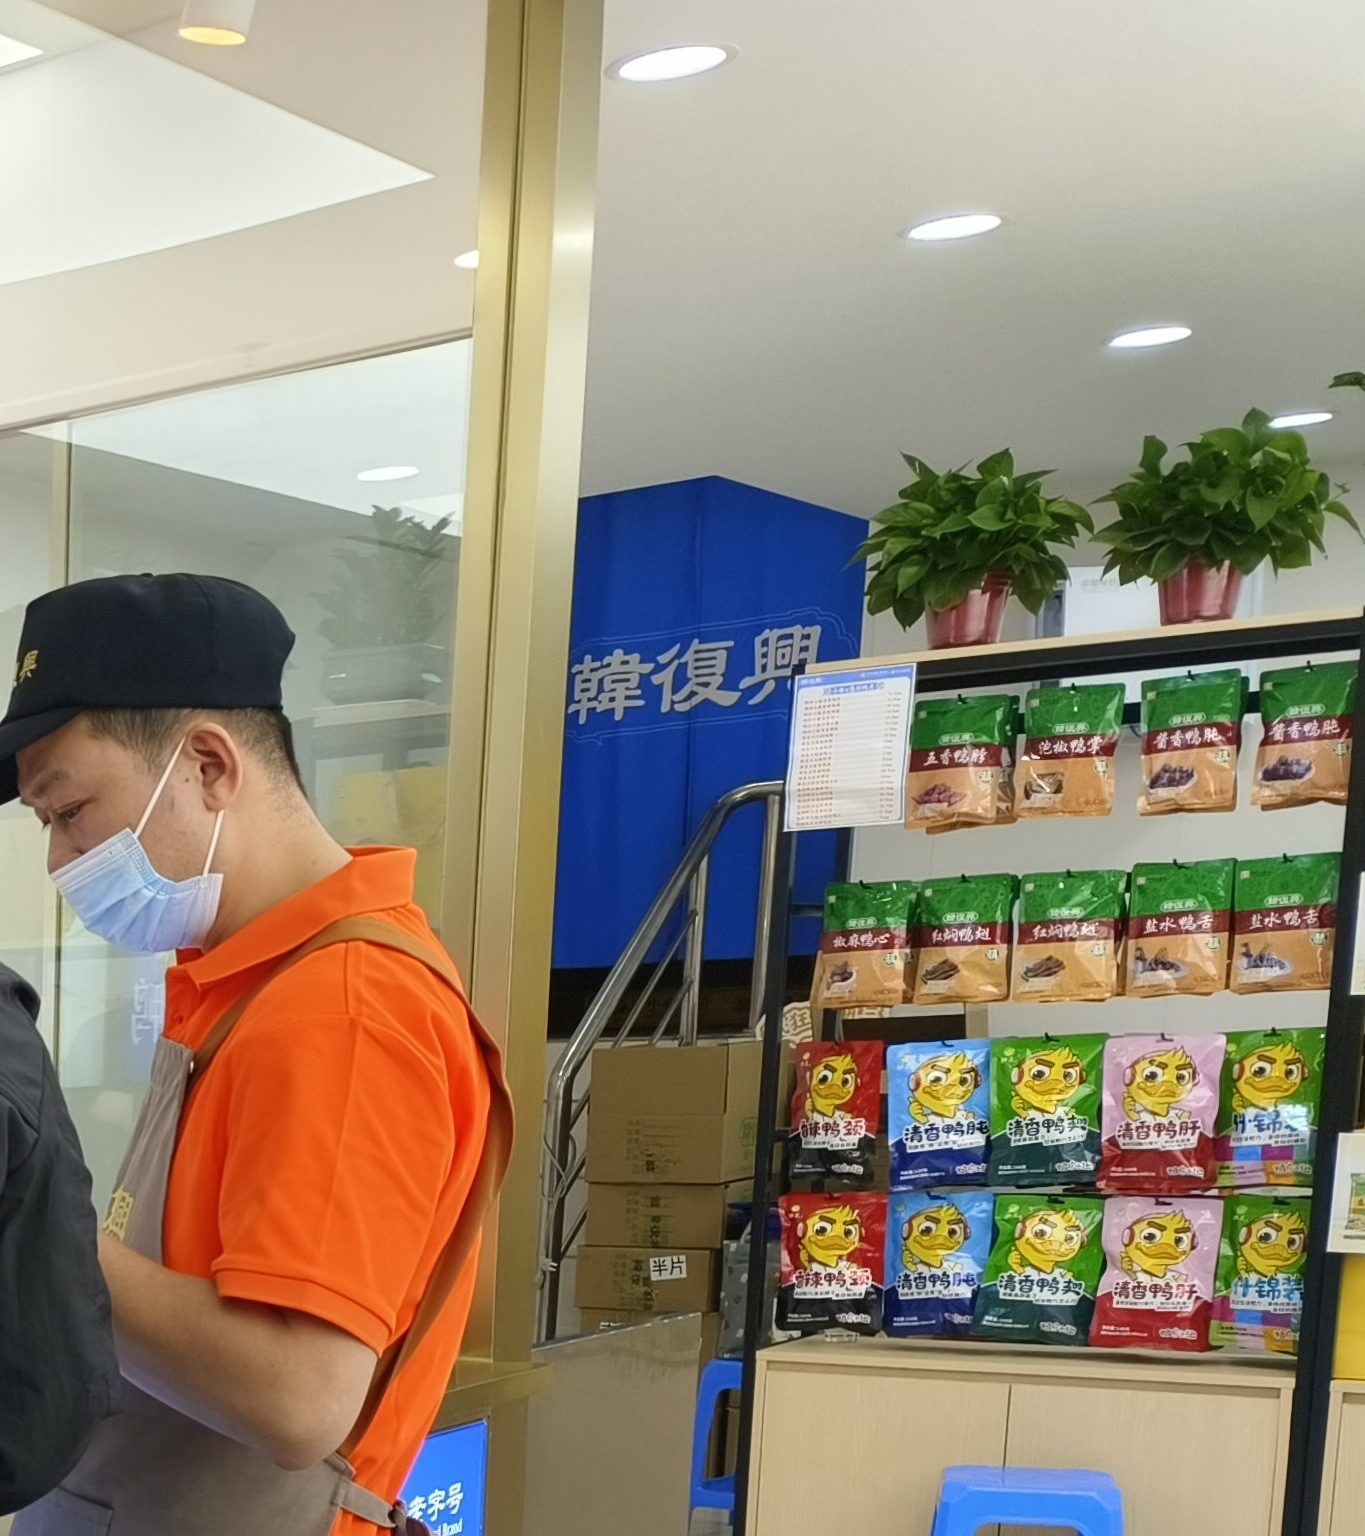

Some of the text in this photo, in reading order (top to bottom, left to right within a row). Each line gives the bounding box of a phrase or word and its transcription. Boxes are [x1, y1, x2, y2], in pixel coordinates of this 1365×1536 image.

[567, 625, 822, 725] 韓復興
[652, 1256, 684, 1278] 半片
